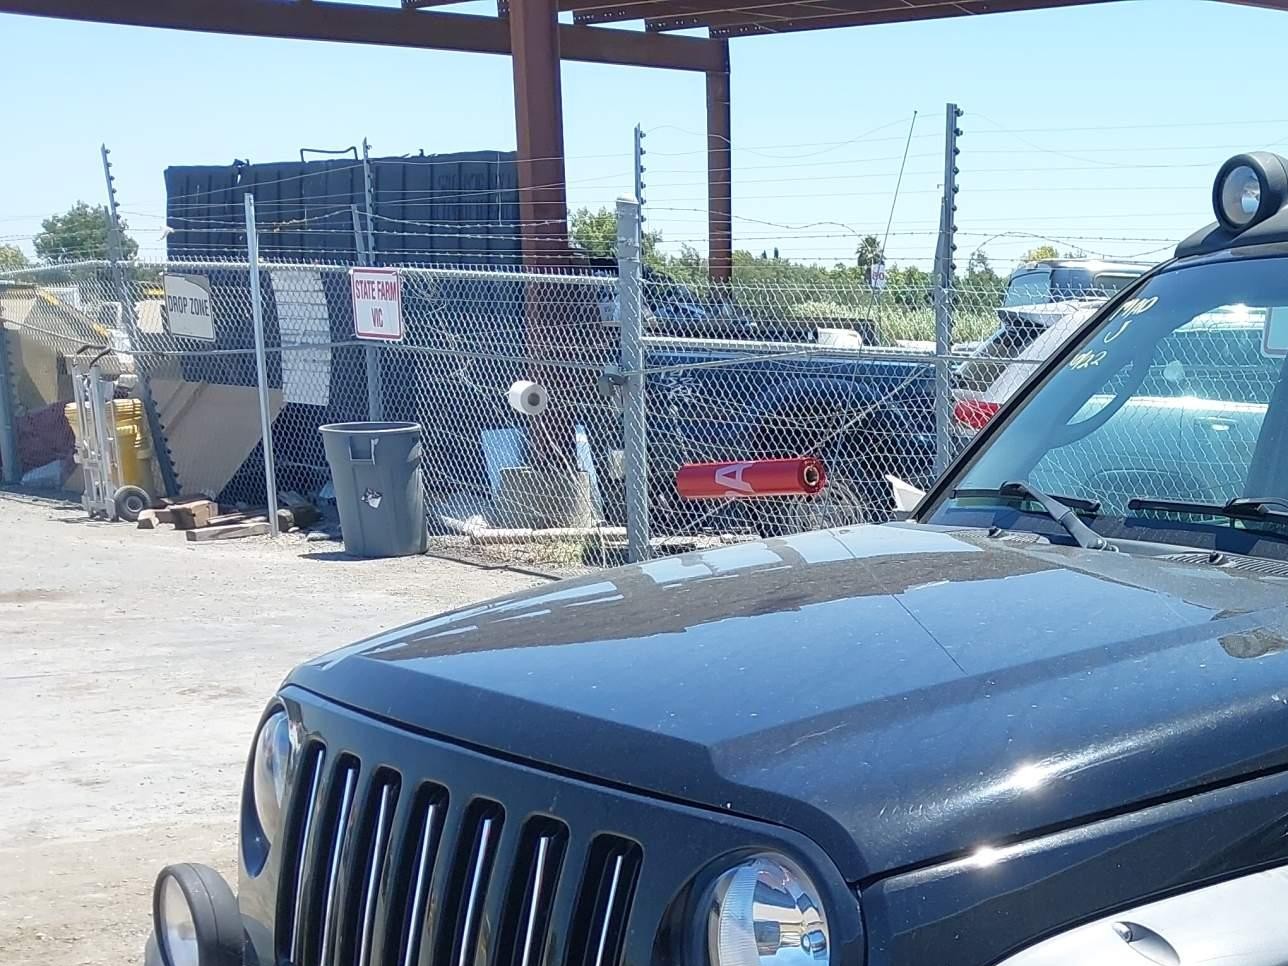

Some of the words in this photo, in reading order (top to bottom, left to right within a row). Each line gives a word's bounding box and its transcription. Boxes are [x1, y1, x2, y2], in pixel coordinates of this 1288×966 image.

[355, 279, 376, 300] STATE
[376, 280, 397, 301] FARM
[167, 295, 188, 314] DROP
[188, 297, 210, 317] ZONE
[371, 307, 384, 328] VIC
